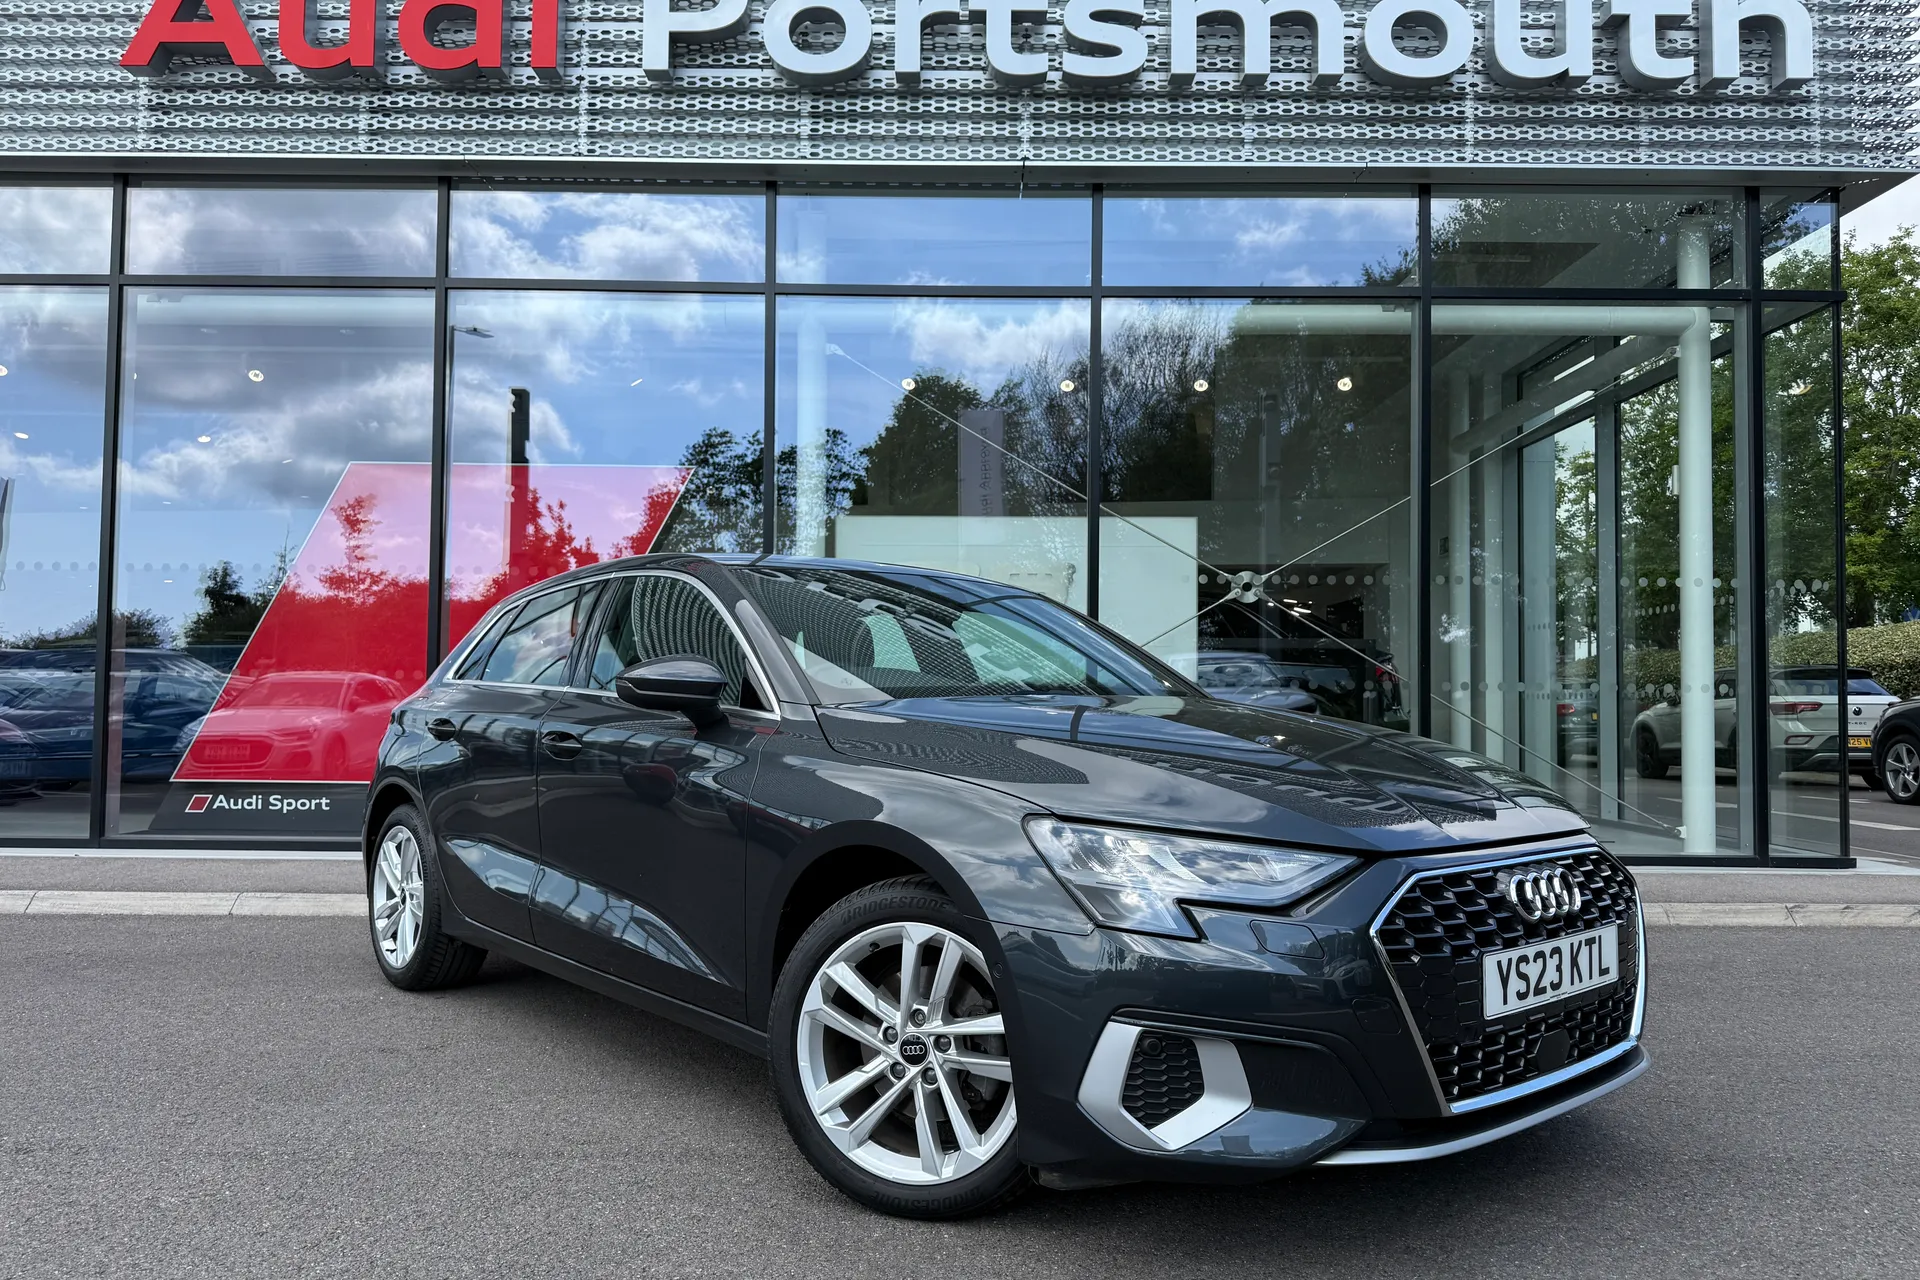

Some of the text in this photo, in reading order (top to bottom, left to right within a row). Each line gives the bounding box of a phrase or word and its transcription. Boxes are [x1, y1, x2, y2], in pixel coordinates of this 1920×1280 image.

[212, 794, 330, 813] Audi Sport
[840, 896, 950, 926] BRIDGESTONE
[1496, 934, 1610, 1006] YS23 KTL
